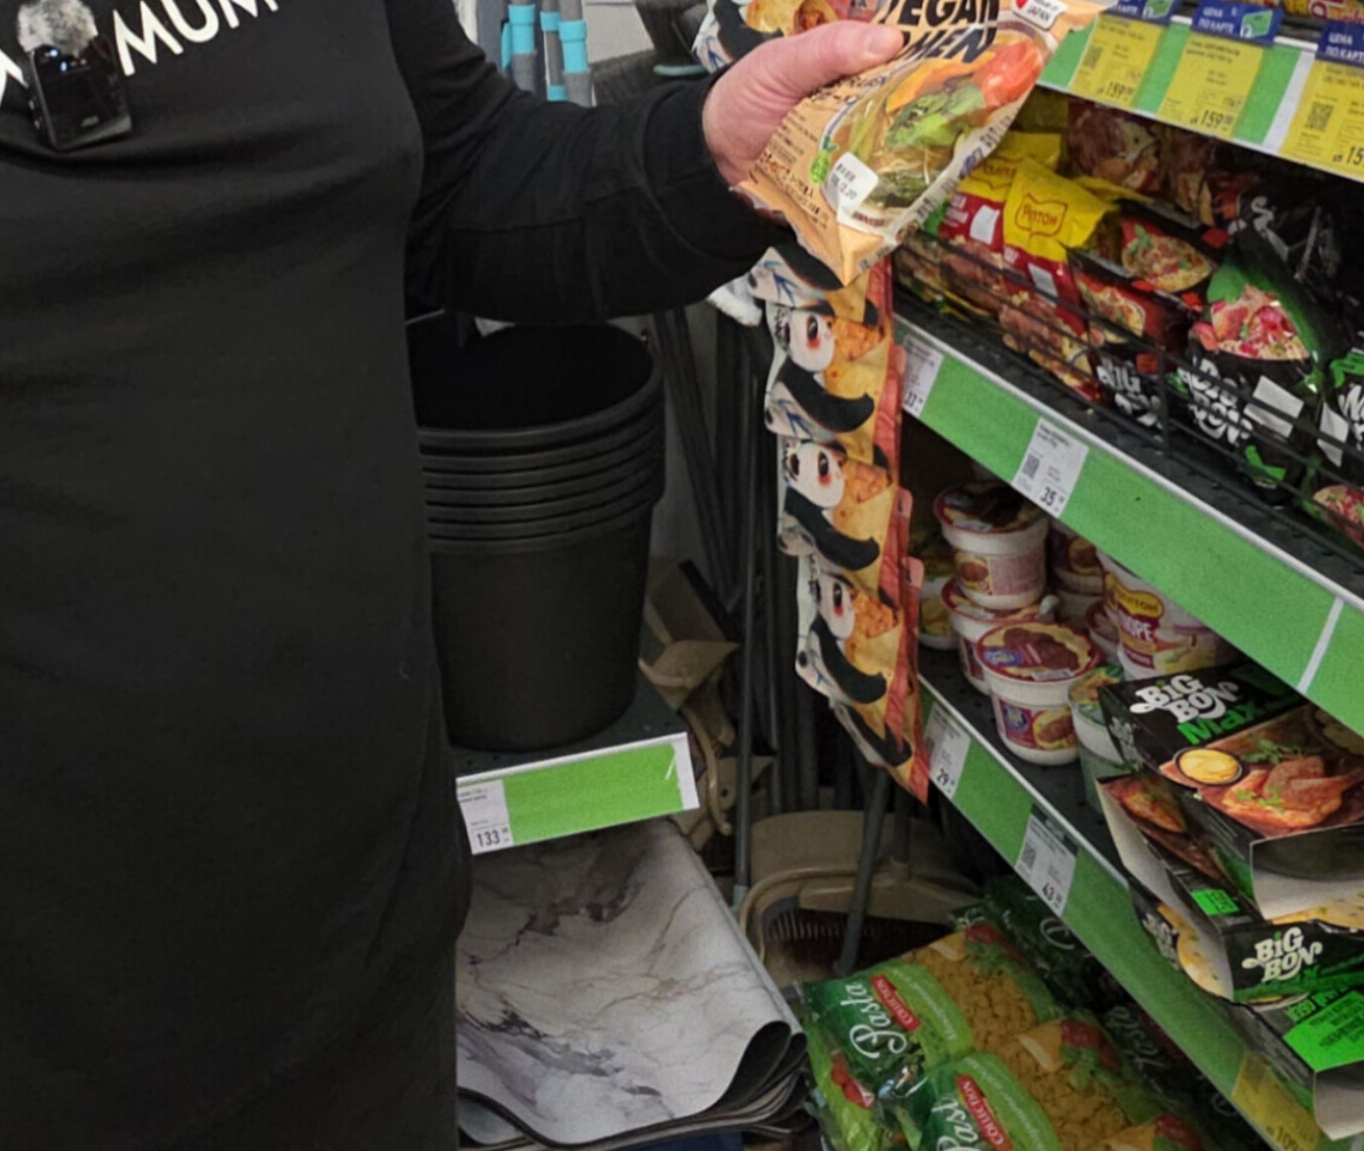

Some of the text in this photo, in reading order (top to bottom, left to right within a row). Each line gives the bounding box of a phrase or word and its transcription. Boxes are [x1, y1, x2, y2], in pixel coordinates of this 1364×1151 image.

[1345, 145, 1364, 166] 15
[1039, 486, 1058, 507] 35
[1169, 681, 1240, 724] BON
[476, 829, 501, 848] 133
[1261, 940, 1323, 984] BON
[839, 981, 909, 1060] Pasta
